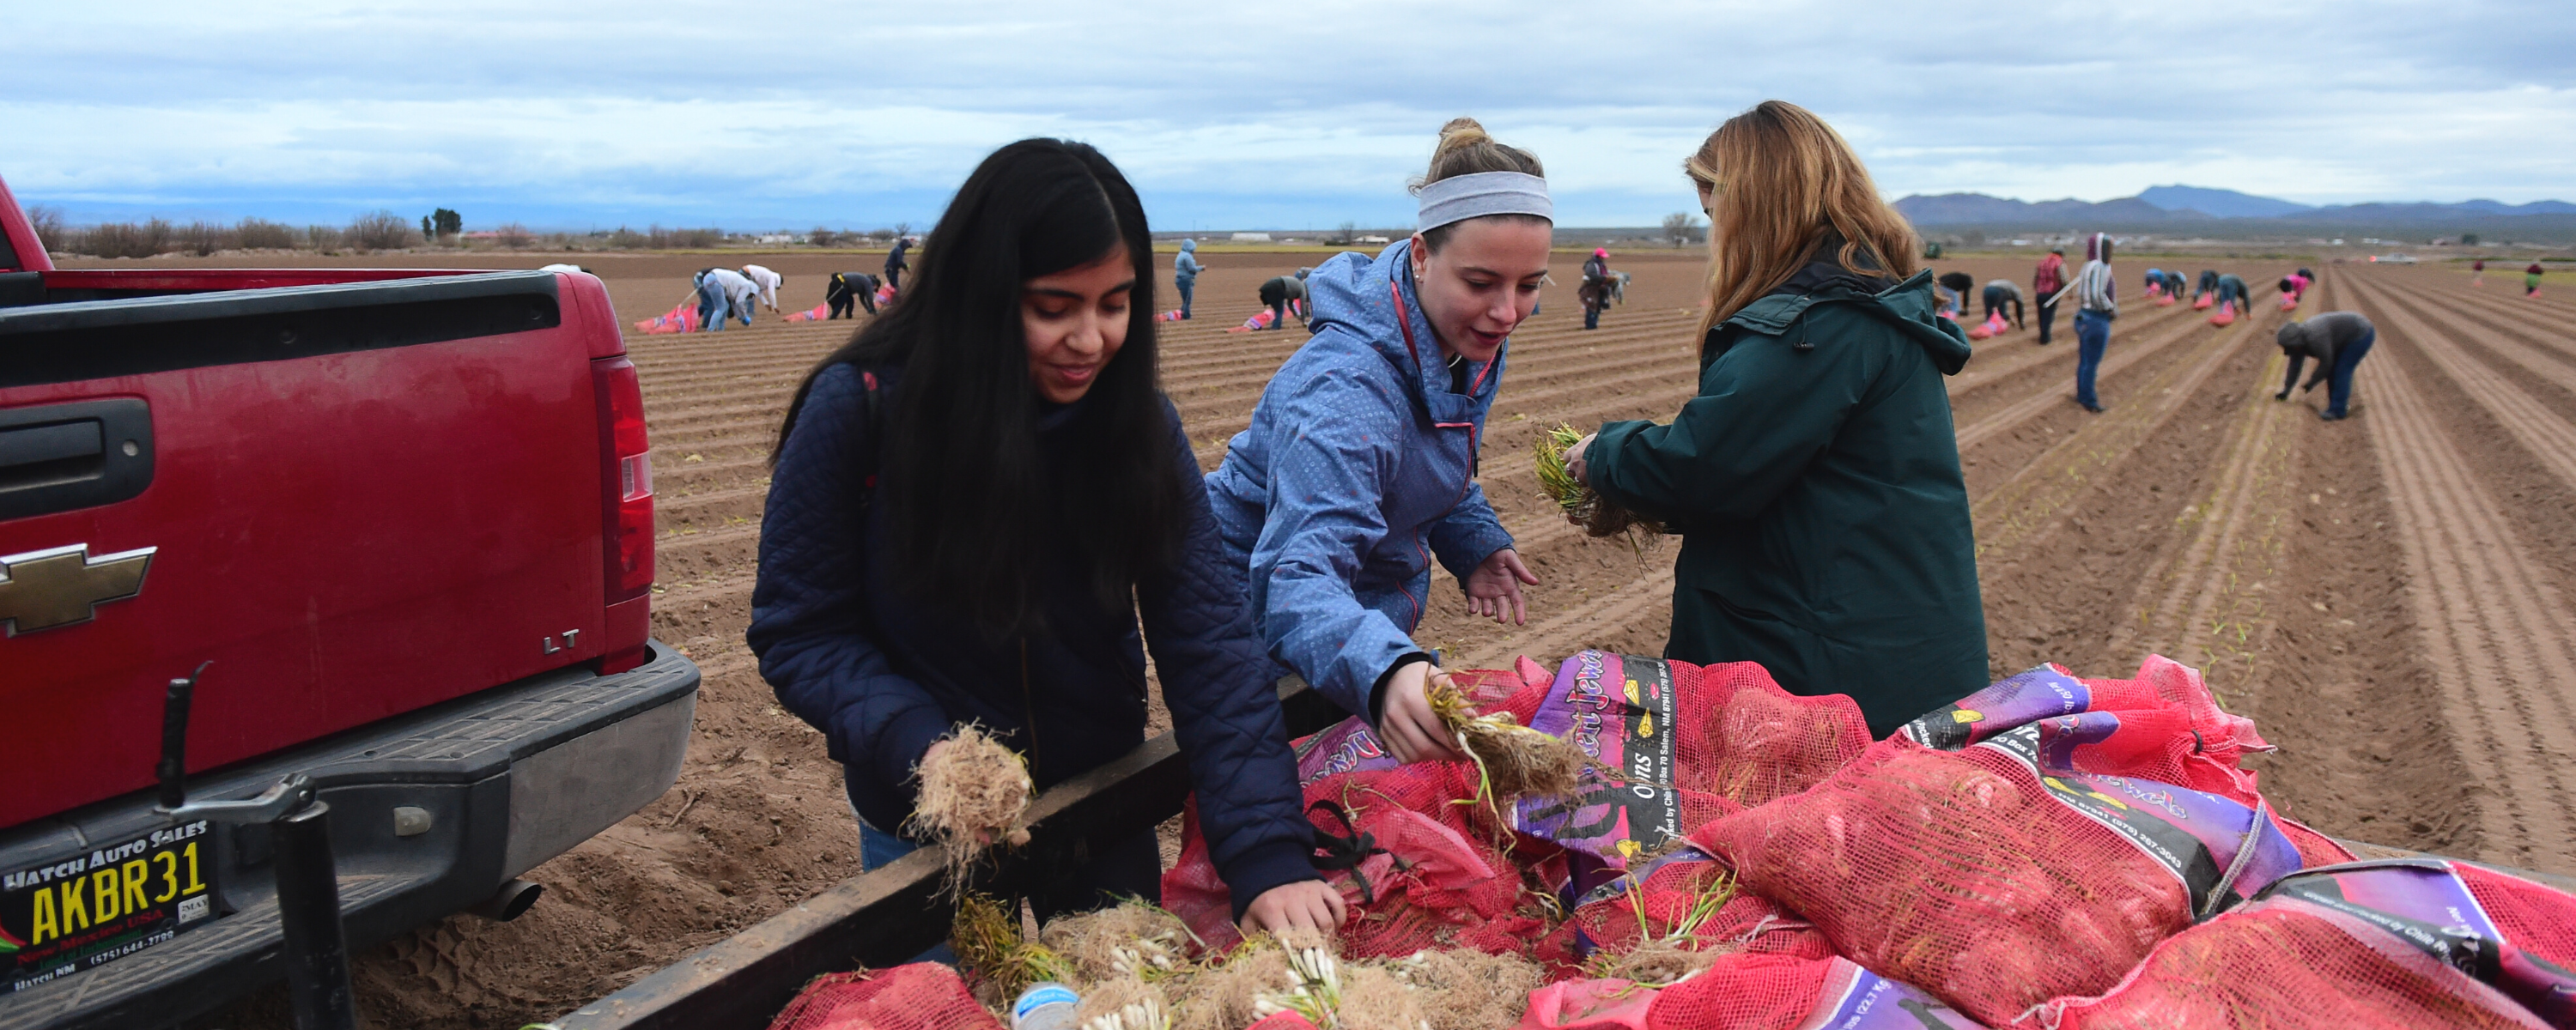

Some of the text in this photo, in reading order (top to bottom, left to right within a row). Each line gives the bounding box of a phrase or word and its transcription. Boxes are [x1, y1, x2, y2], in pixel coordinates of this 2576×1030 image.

[544, 628, 579, 655] LT
[1567, 649, 1610, 711] Jewel
[1660, 678, 1671, 693] (575)
[1662, 694, 1671, 712] 87941
[1662, 713, 1671, 727] NM
[1660, 728, 1671, 755] Salem,
[1915, 722, 1934, 749] Packed
[1660, 756, 1668, 766] 70
[2008, 739, 2028, 753] Box
[2027, 749, 2038, 762] 70
[1660, 766, 1668, 779] Box
[2088, 773, 2187, 819] ewels
[1666, 808, 1675, 817] by
[2078, 802, 2109, 820] 87941
[2111, 818, 2139, 837] (575)
[2139, 833, 2182, 869] 267-3043
[89, 839, 147, 869] AUTO
[33, 841, 206, 947] AKBR31
[17, 909, 164, 966] New Mexico USA
[2405, 928, 2435, 946] Chile
[56, 963, 76, 977] NM
[90, 948, 119, 966] (575)
[1856, 992, 1878, 1015] (22.7
